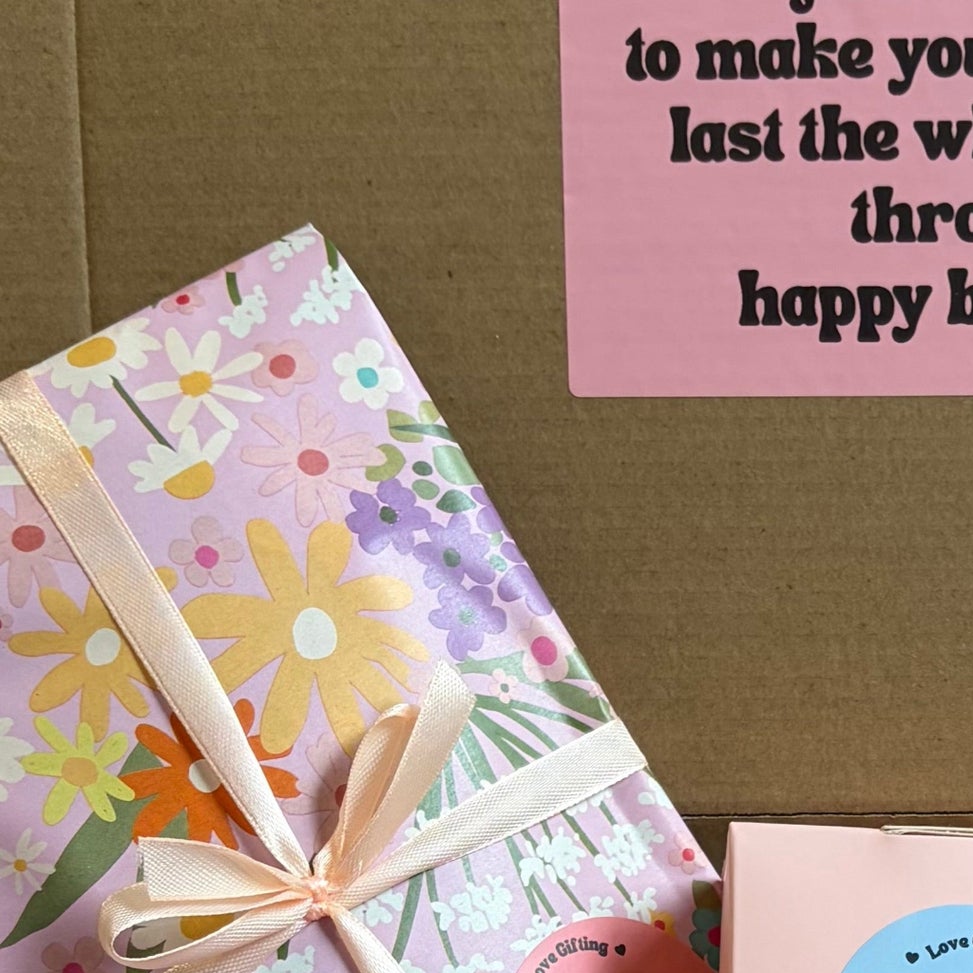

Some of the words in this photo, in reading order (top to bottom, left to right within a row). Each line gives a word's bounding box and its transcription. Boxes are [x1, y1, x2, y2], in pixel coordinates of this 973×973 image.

[625, 27, 681, 81] to
[696, 22, 875, 80] make
[670, 106, 785, 163] last
[800, 105, 899, 162] the
[738, 269, 932, 343] happy
[555, 936, 609, 960] Gifting
[925, 935, 970, 961] Love
